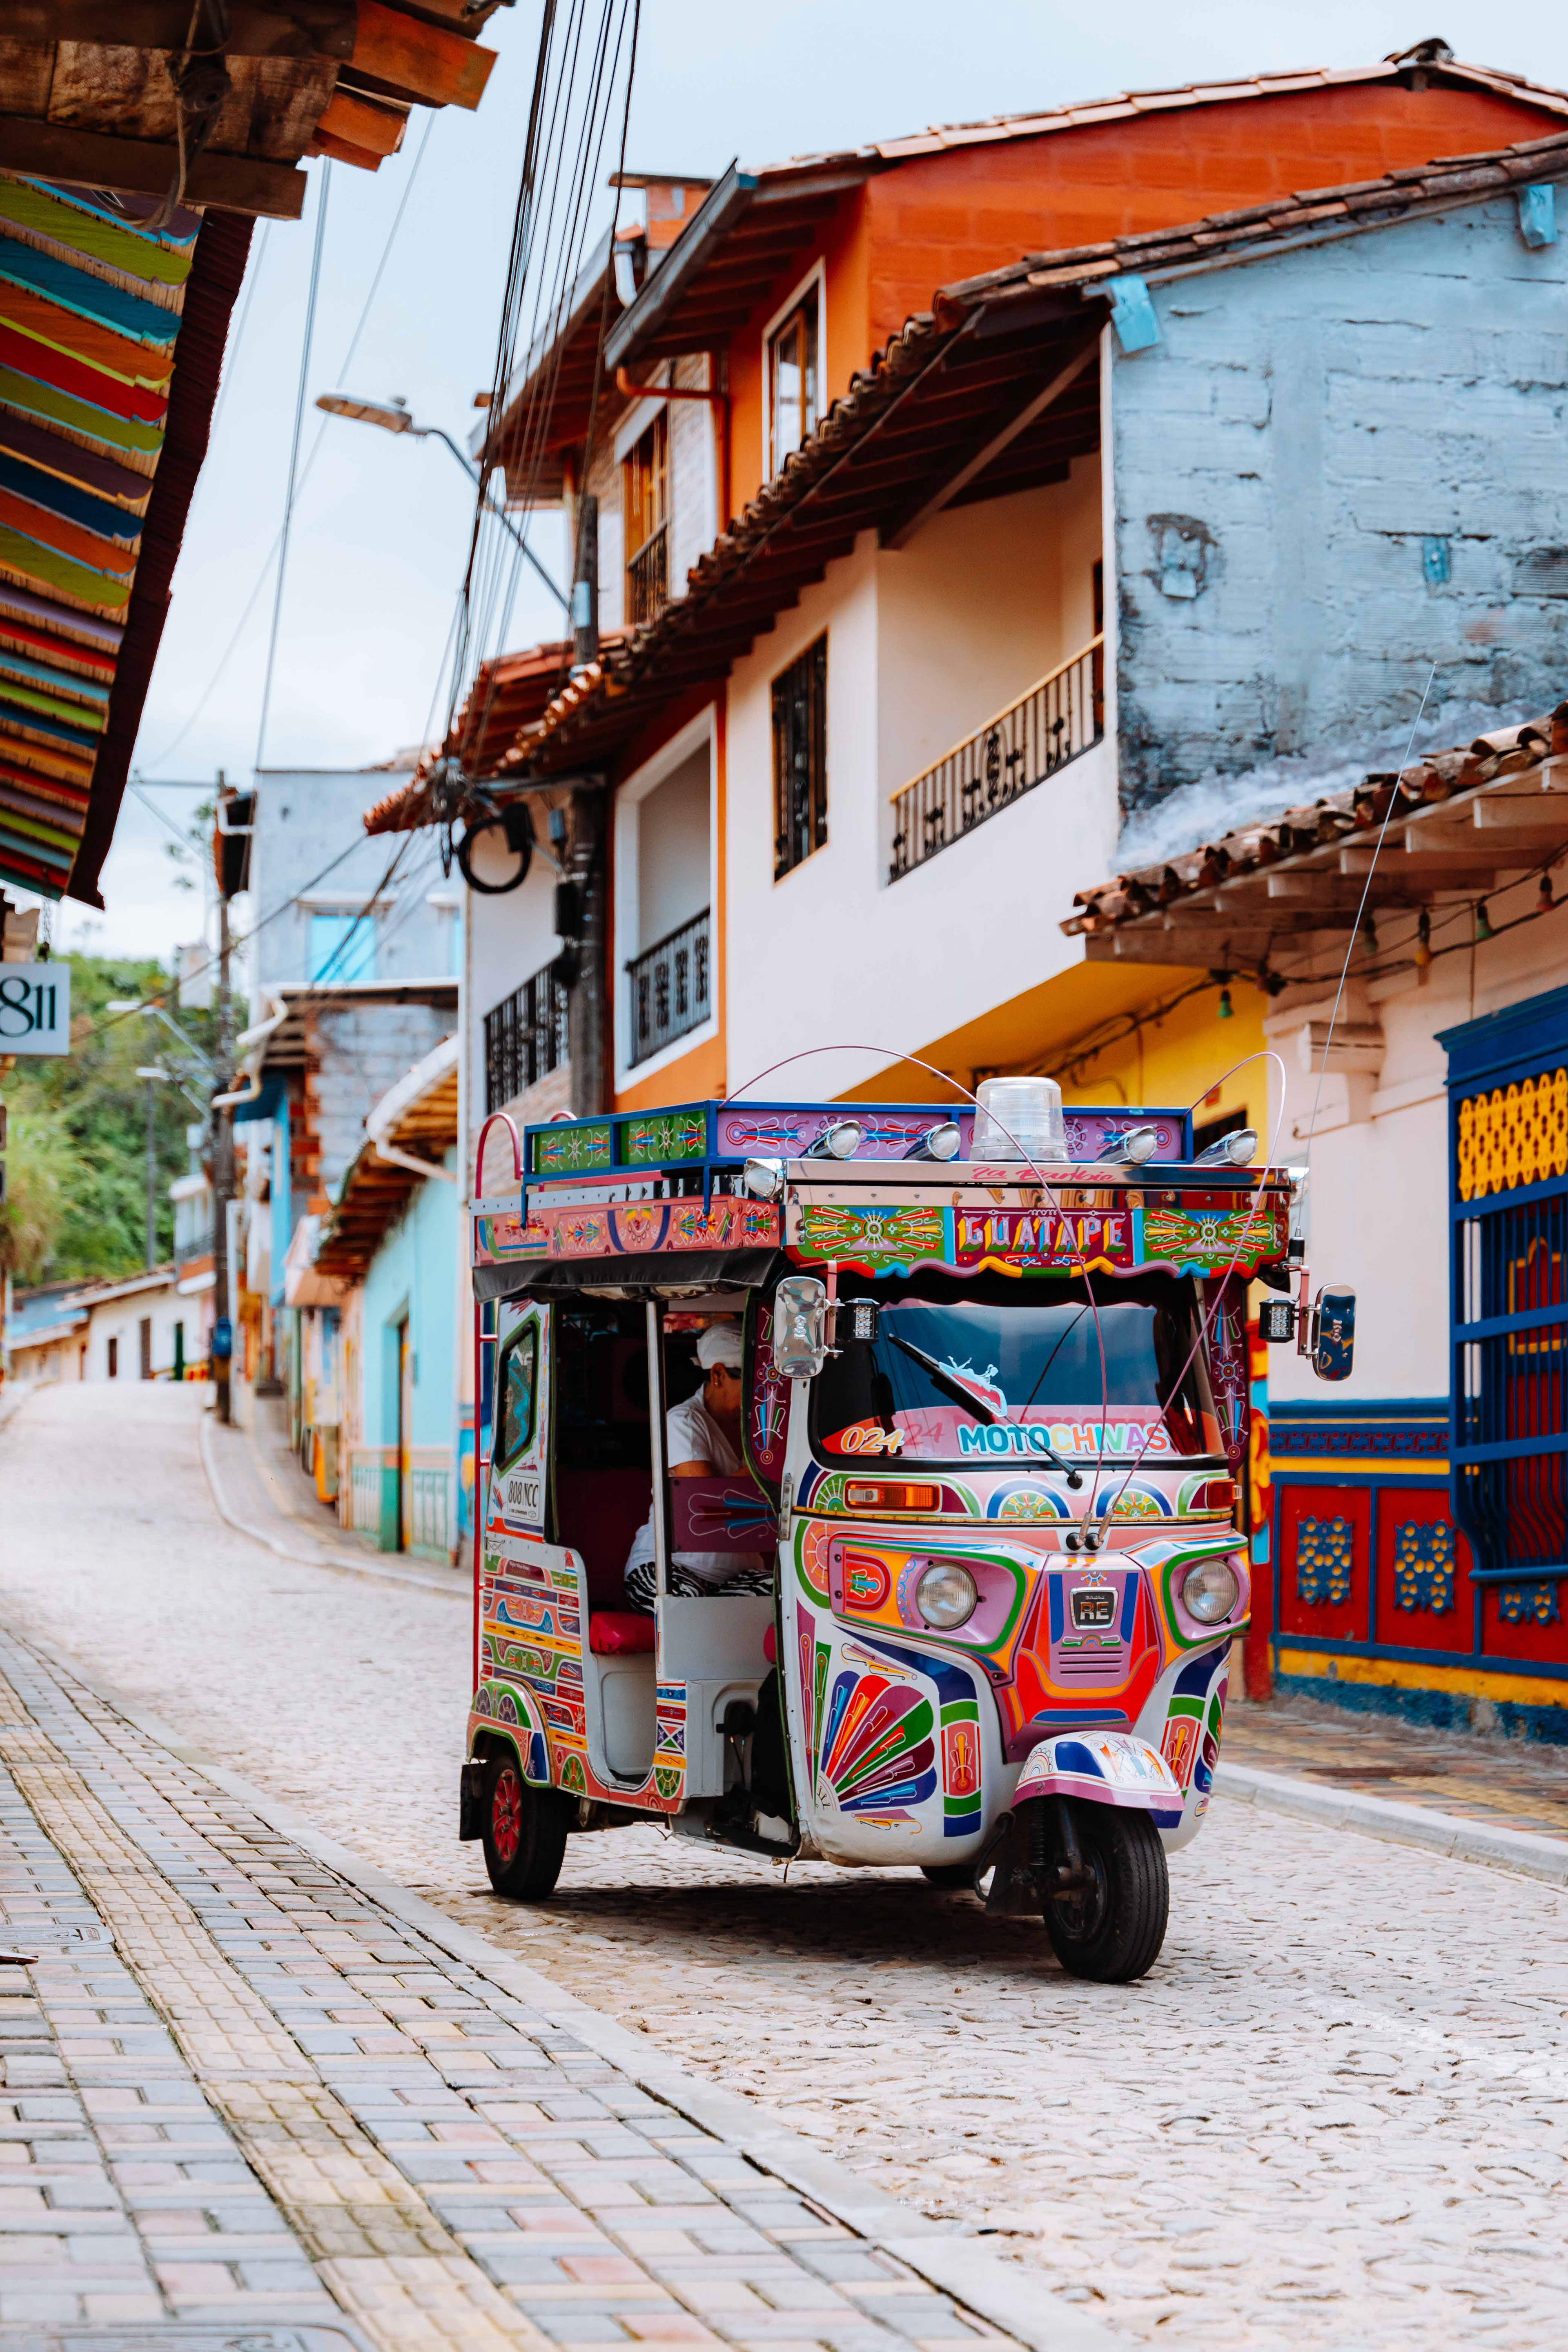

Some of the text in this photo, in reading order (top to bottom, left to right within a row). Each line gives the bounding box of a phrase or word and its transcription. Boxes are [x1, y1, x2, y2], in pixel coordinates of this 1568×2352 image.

[972, 1167, 1117, 1181] La Barbie
[958, 1216, 1127, 1252] GUATAPE
[841, 1427, 905, 1454] 024
[957, 1423, 1171, 1455] MOTOCHIVAS
[1080, 1601, 1109, 1620] RE
